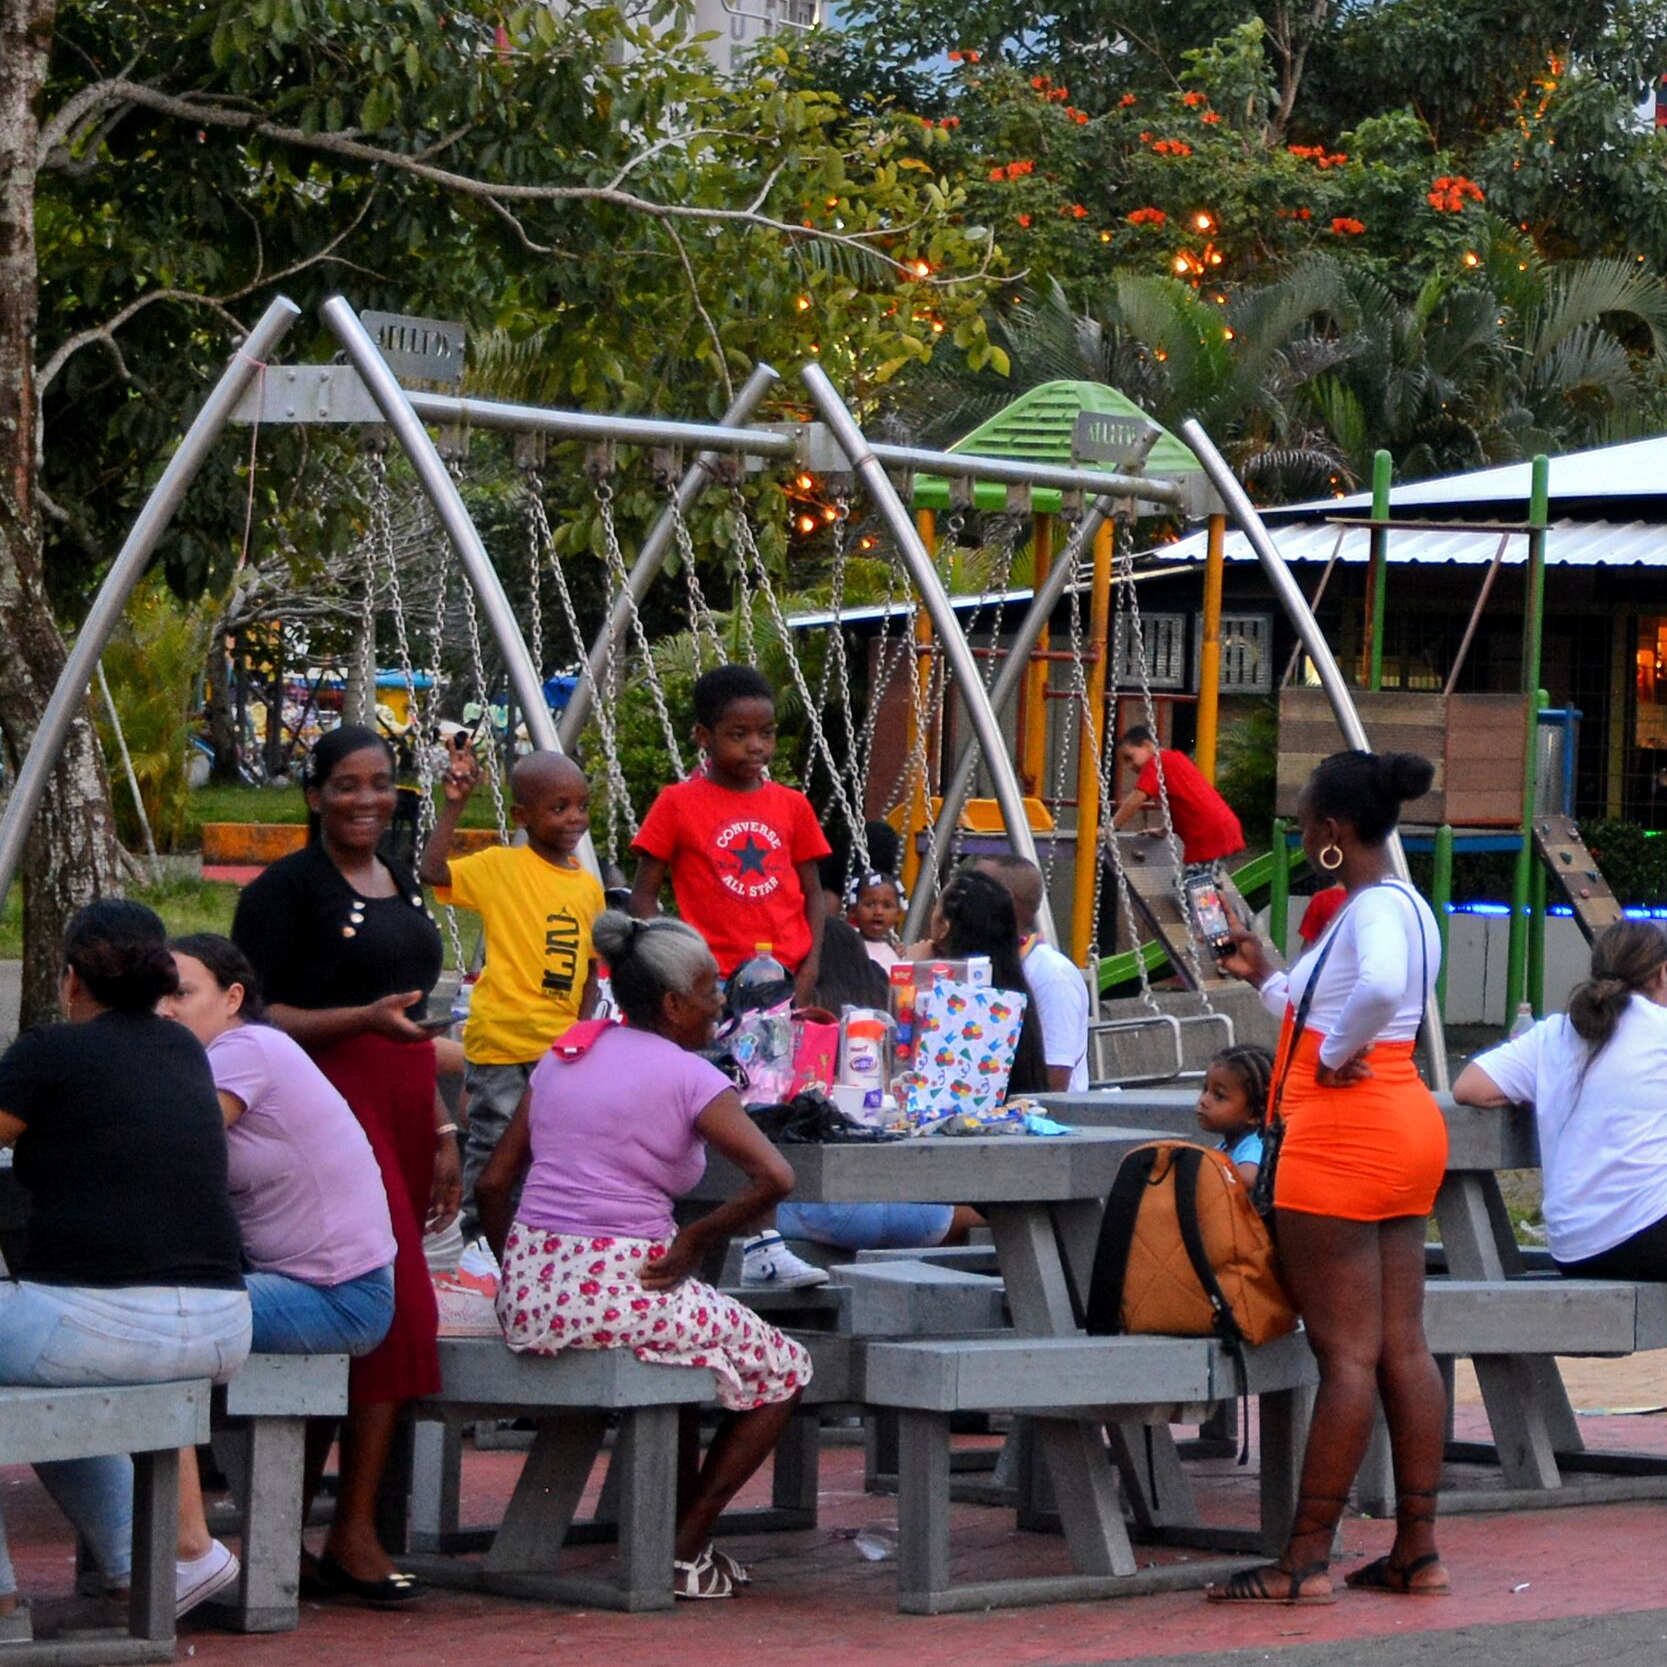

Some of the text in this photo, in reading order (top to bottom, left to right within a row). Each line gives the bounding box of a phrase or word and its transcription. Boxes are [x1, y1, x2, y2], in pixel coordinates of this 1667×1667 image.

[716, 821, 782, 849] CONVERSE
[722, 875, 779, 897] ALL STAR
